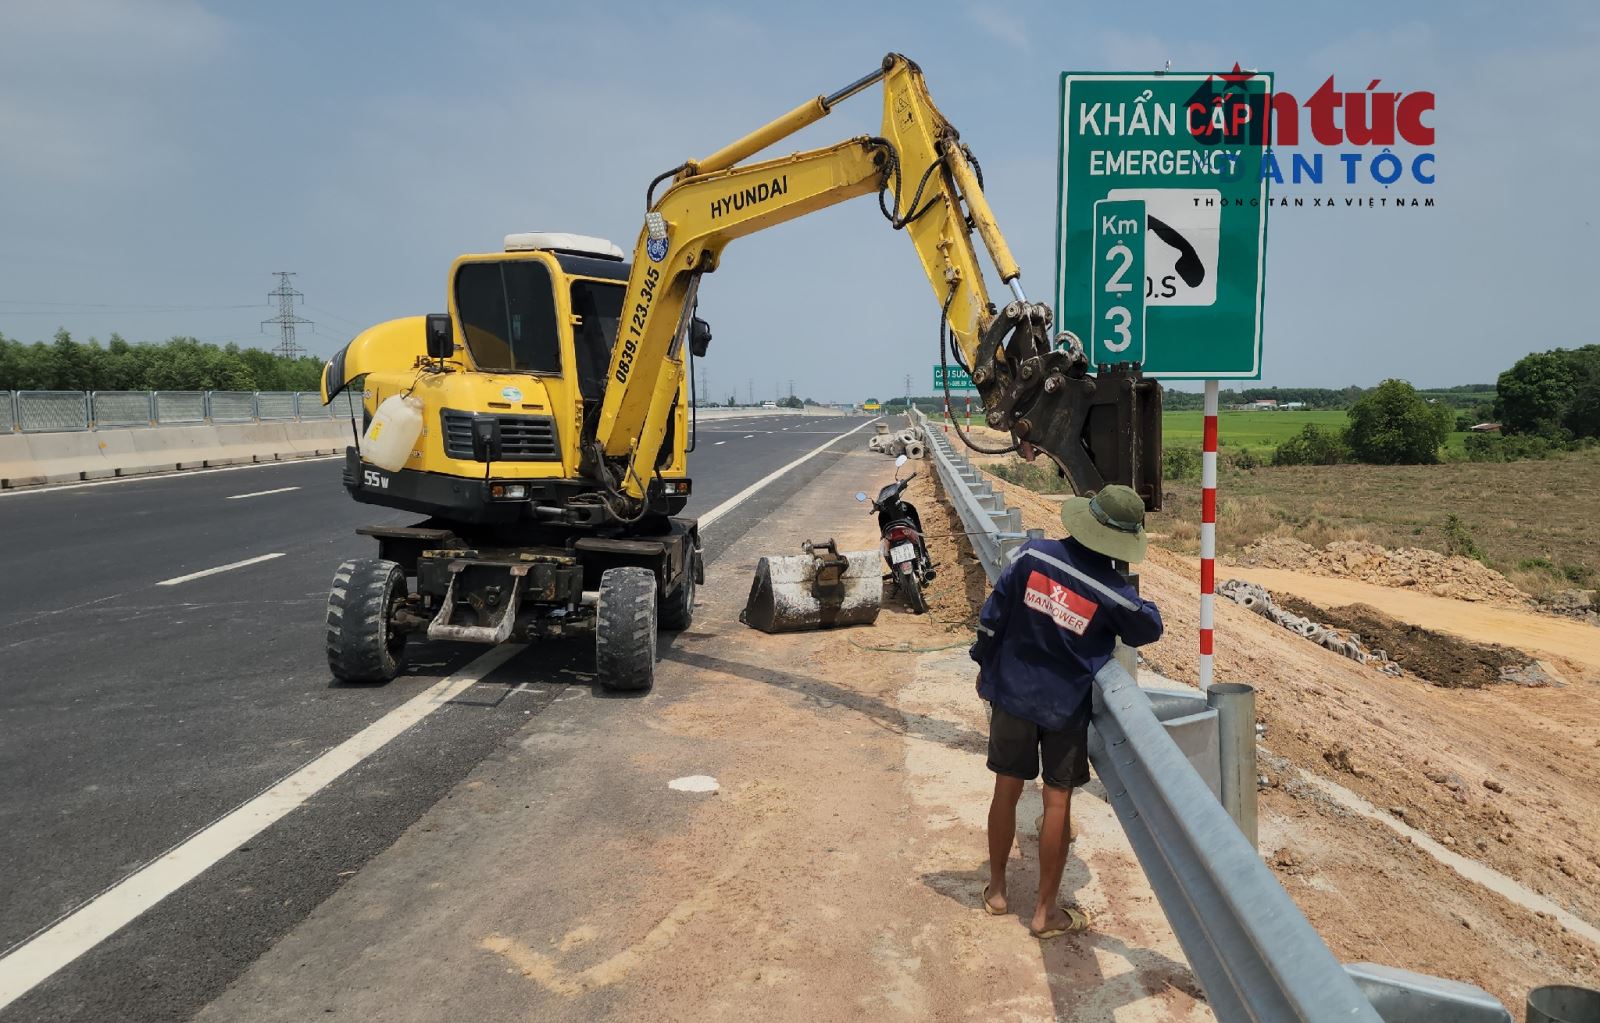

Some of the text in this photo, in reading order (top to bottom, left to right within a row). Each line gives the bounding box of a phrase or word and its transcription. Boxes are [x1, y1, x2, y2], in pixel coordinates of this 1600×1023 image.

[1079, 89, 1253, 136] KHẨN CẤP
[1089, 149, 1241, 175] EMERGENCY
[711, 175, 788, 219] HYUNDAI
[1102, 215, 1138, 236] Km
[1104, 244, 1134, 293] 2
[615, 267, 660, 384] 0839.123.345
[1103, 305, 1132, 353] 3
